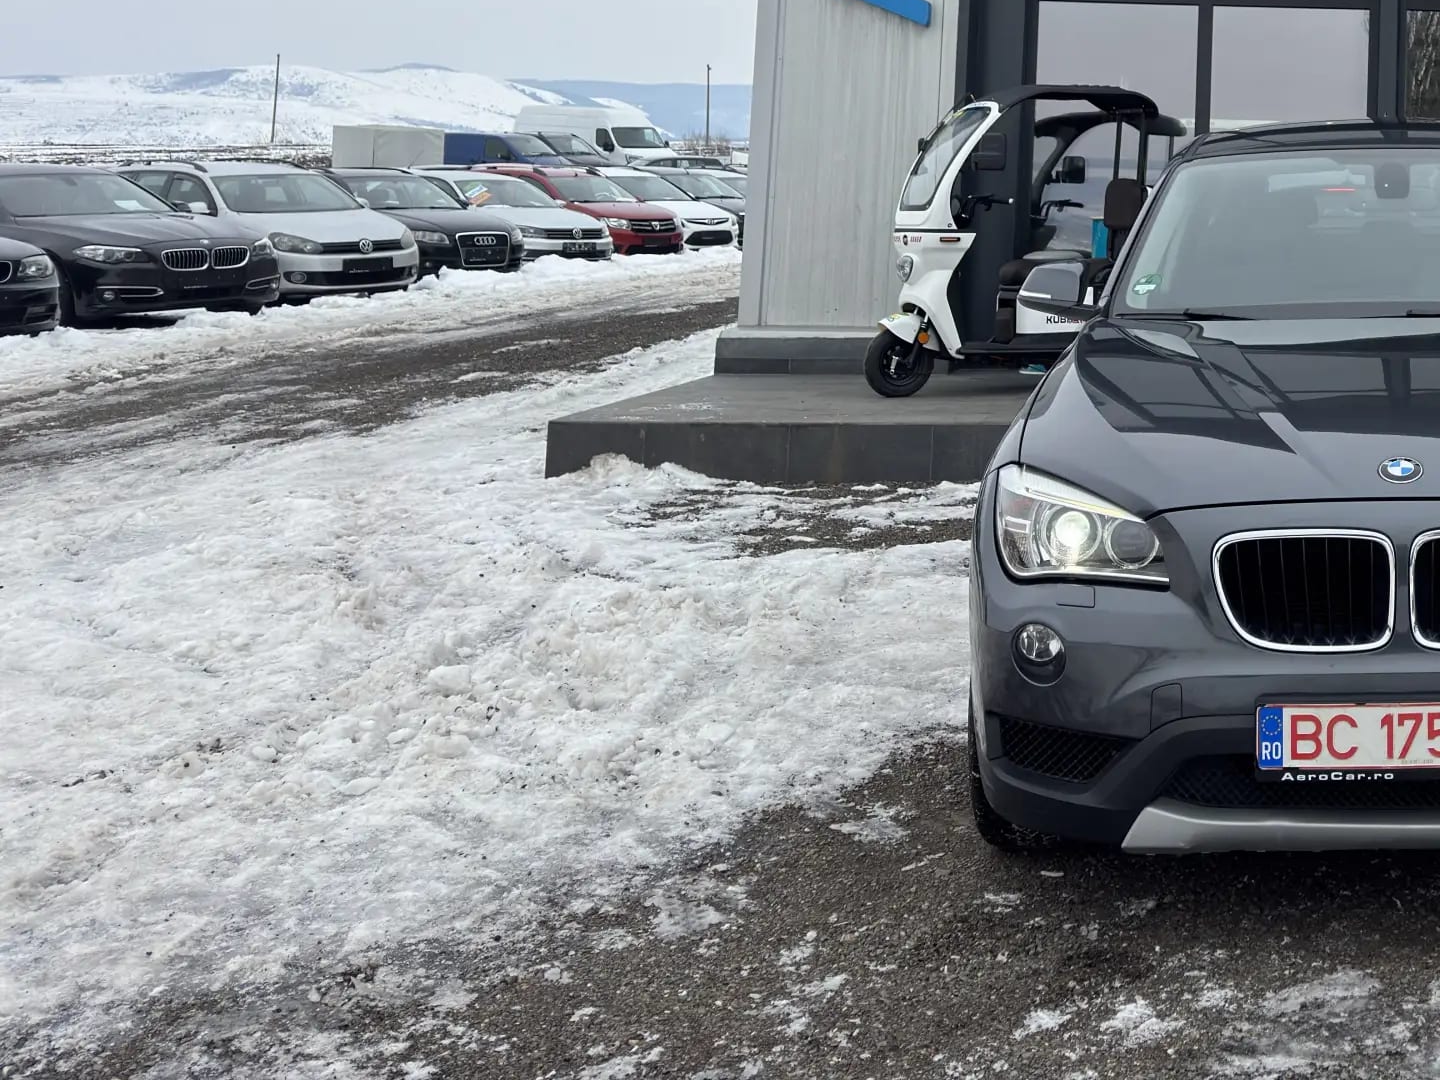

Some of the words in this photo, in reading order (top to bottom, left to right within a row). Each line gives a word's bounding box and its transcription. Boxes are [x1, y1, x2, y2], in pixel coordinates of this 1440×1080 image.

[1290, 714, 1358, 760] BC
[1261, 741, 1282, 761] RO
[1281, 771, 1394, 782] AeroCar.ro
